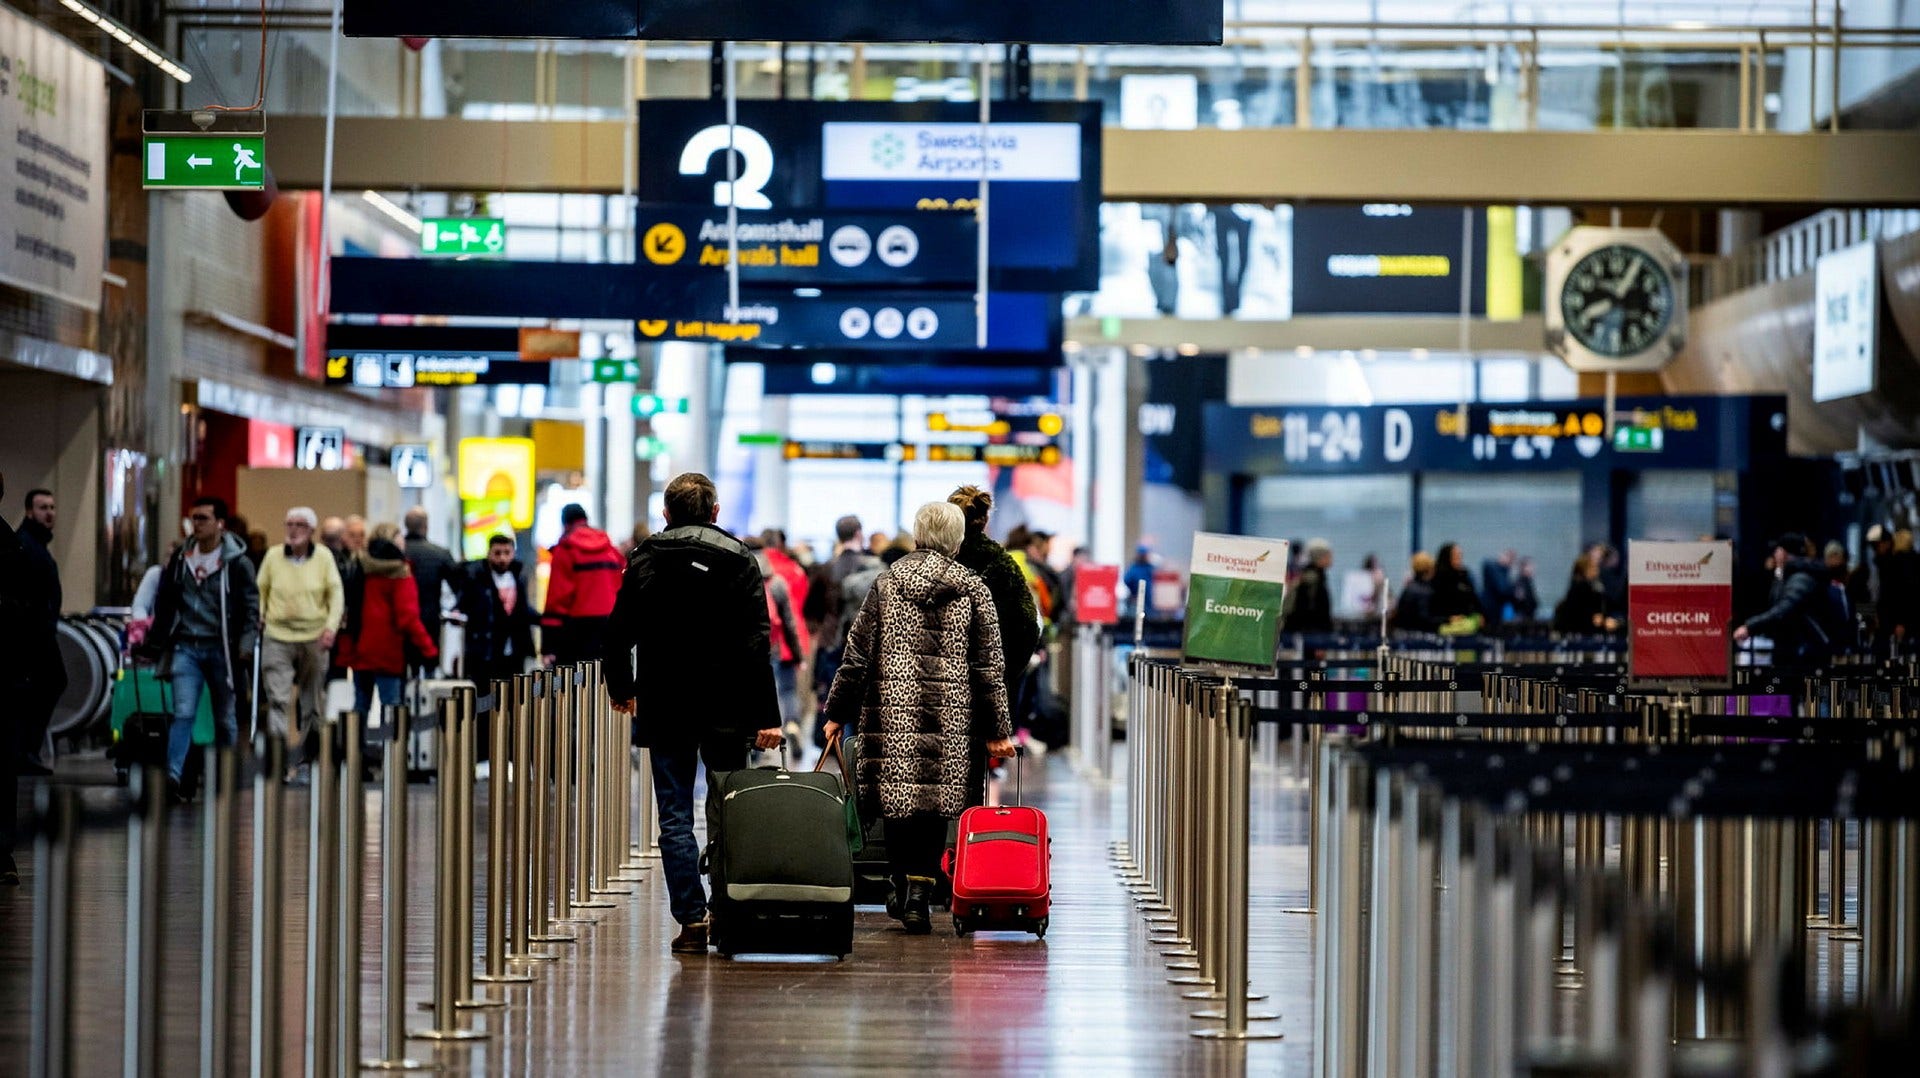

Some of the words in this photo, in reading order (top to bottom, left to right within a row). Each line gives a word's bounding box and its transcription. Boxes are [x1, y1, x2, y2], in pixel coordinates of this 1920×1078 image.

[917, 154, 1002, 172] Airpors
[699, 218, 824, 241] Anomsthall
[699, 244, 777, 266] Arrvals
[1284, 411, 1362, 462] 11-24
[1383, 408, 1414, 462] D
[1206, 552, 1258, 567] Ethiopian
[1645, 561, 1702, 572] Ethiopian
[1205, 598, 1264, 622] Economy
[1646, 611, 1710, 624] CHECK-IN
